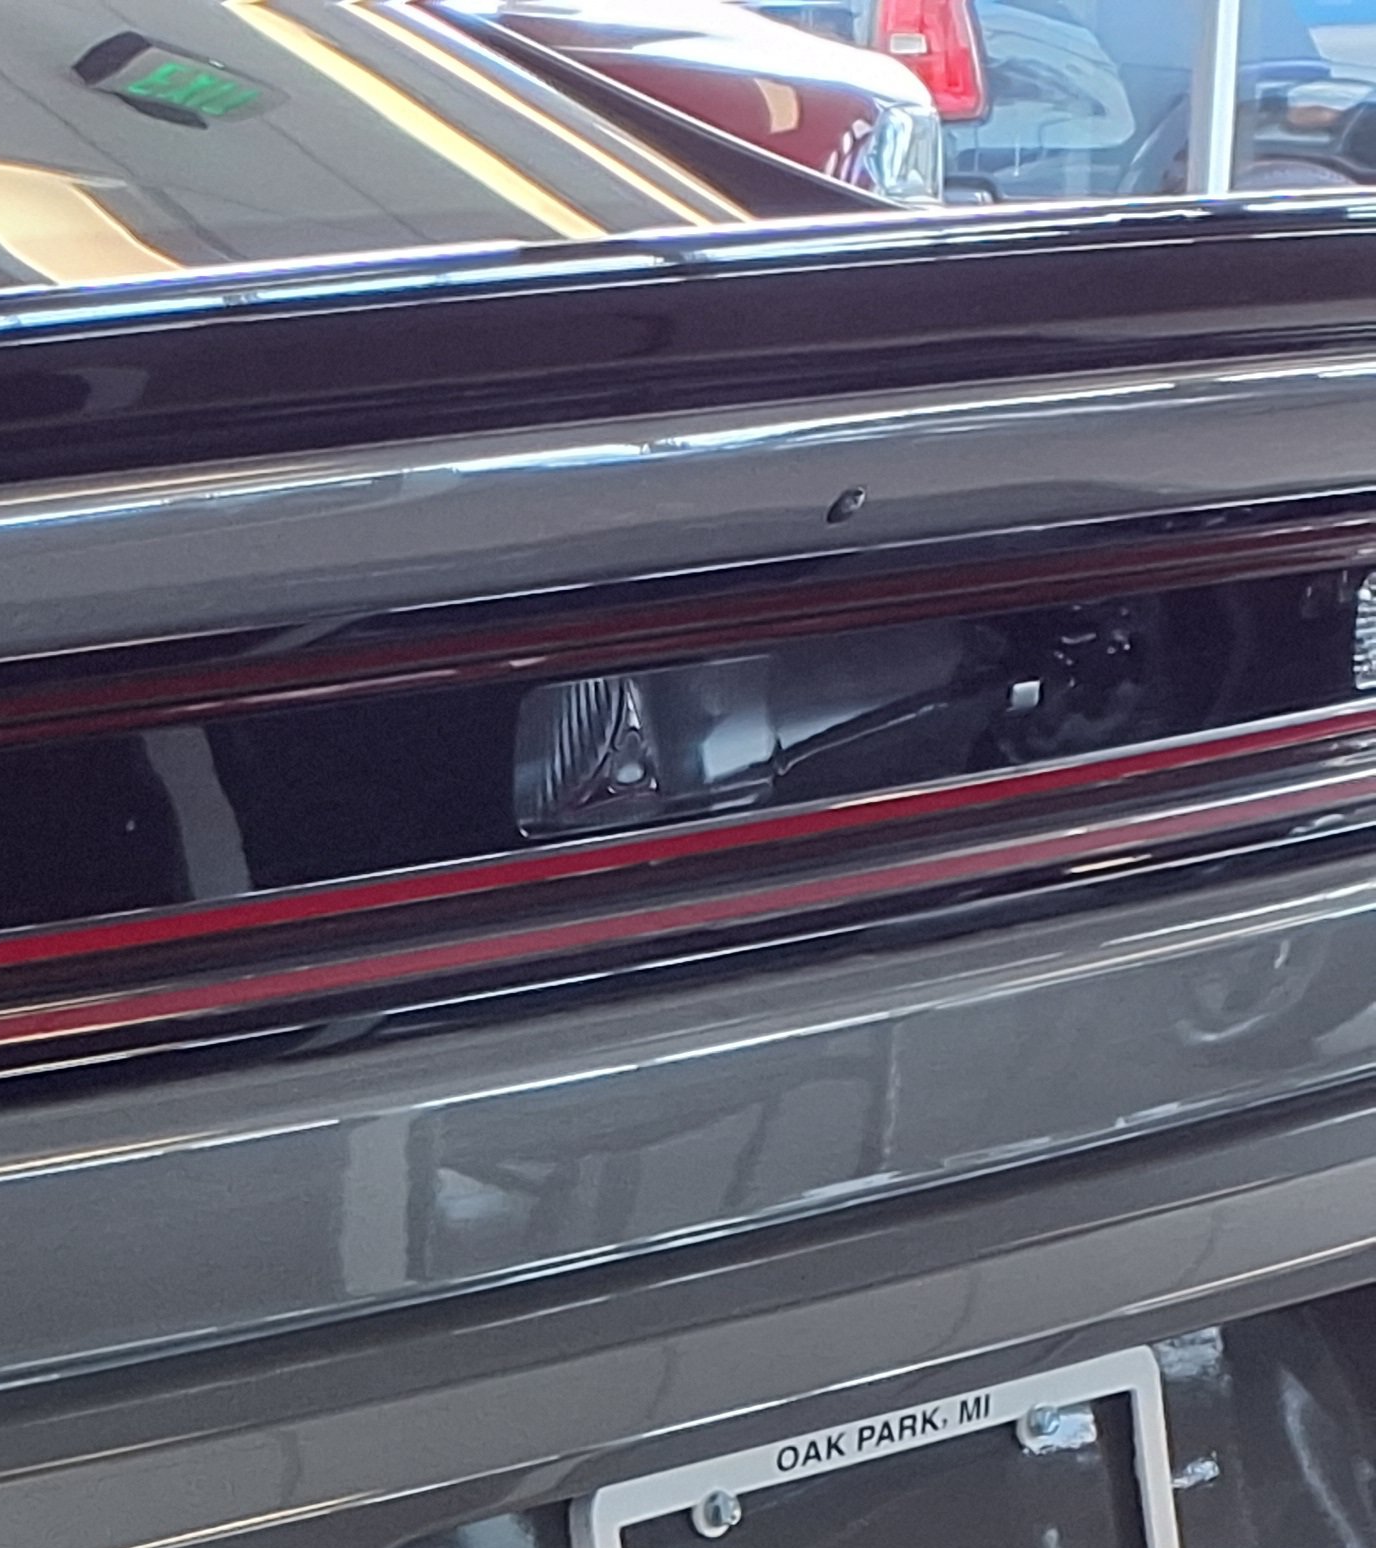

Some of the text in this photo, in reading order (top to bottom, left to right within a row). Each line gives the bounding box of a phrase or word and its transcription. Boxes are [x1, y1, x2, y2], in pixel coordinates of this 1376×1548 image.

[776, 1393, 991, 1472] OAK PARK, MI
